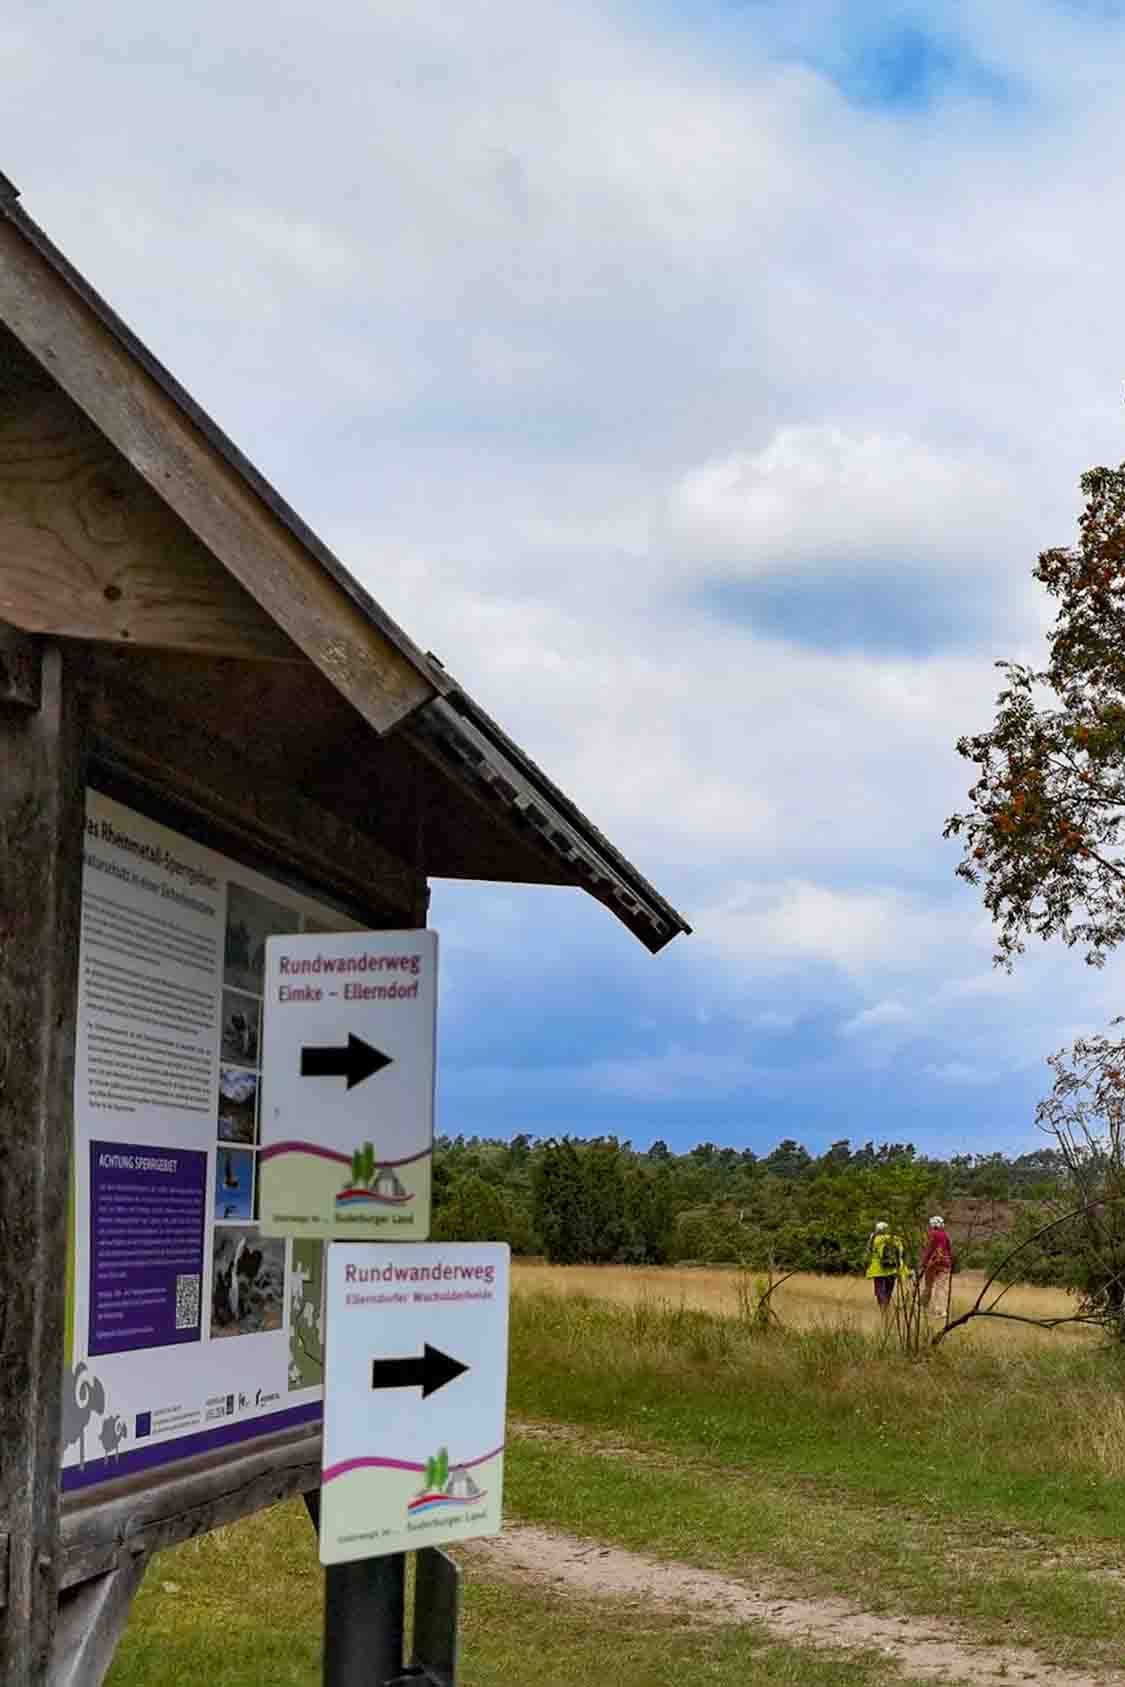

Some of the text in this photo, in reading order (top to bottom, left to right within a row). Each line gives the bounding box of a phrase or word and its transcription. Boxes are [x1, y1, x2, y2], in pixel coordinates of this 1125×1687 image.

[279, 953, 421, 975] Rundwanderweg
[278, 984, 323, 1003] Eimke
[344, 981, 419, 1001] Ellerndorf
[98, 1152, 178, 1175] ACHTUNG SPERRGEBIET
[344, 1263, 496, 1284] Rundwanderweg
